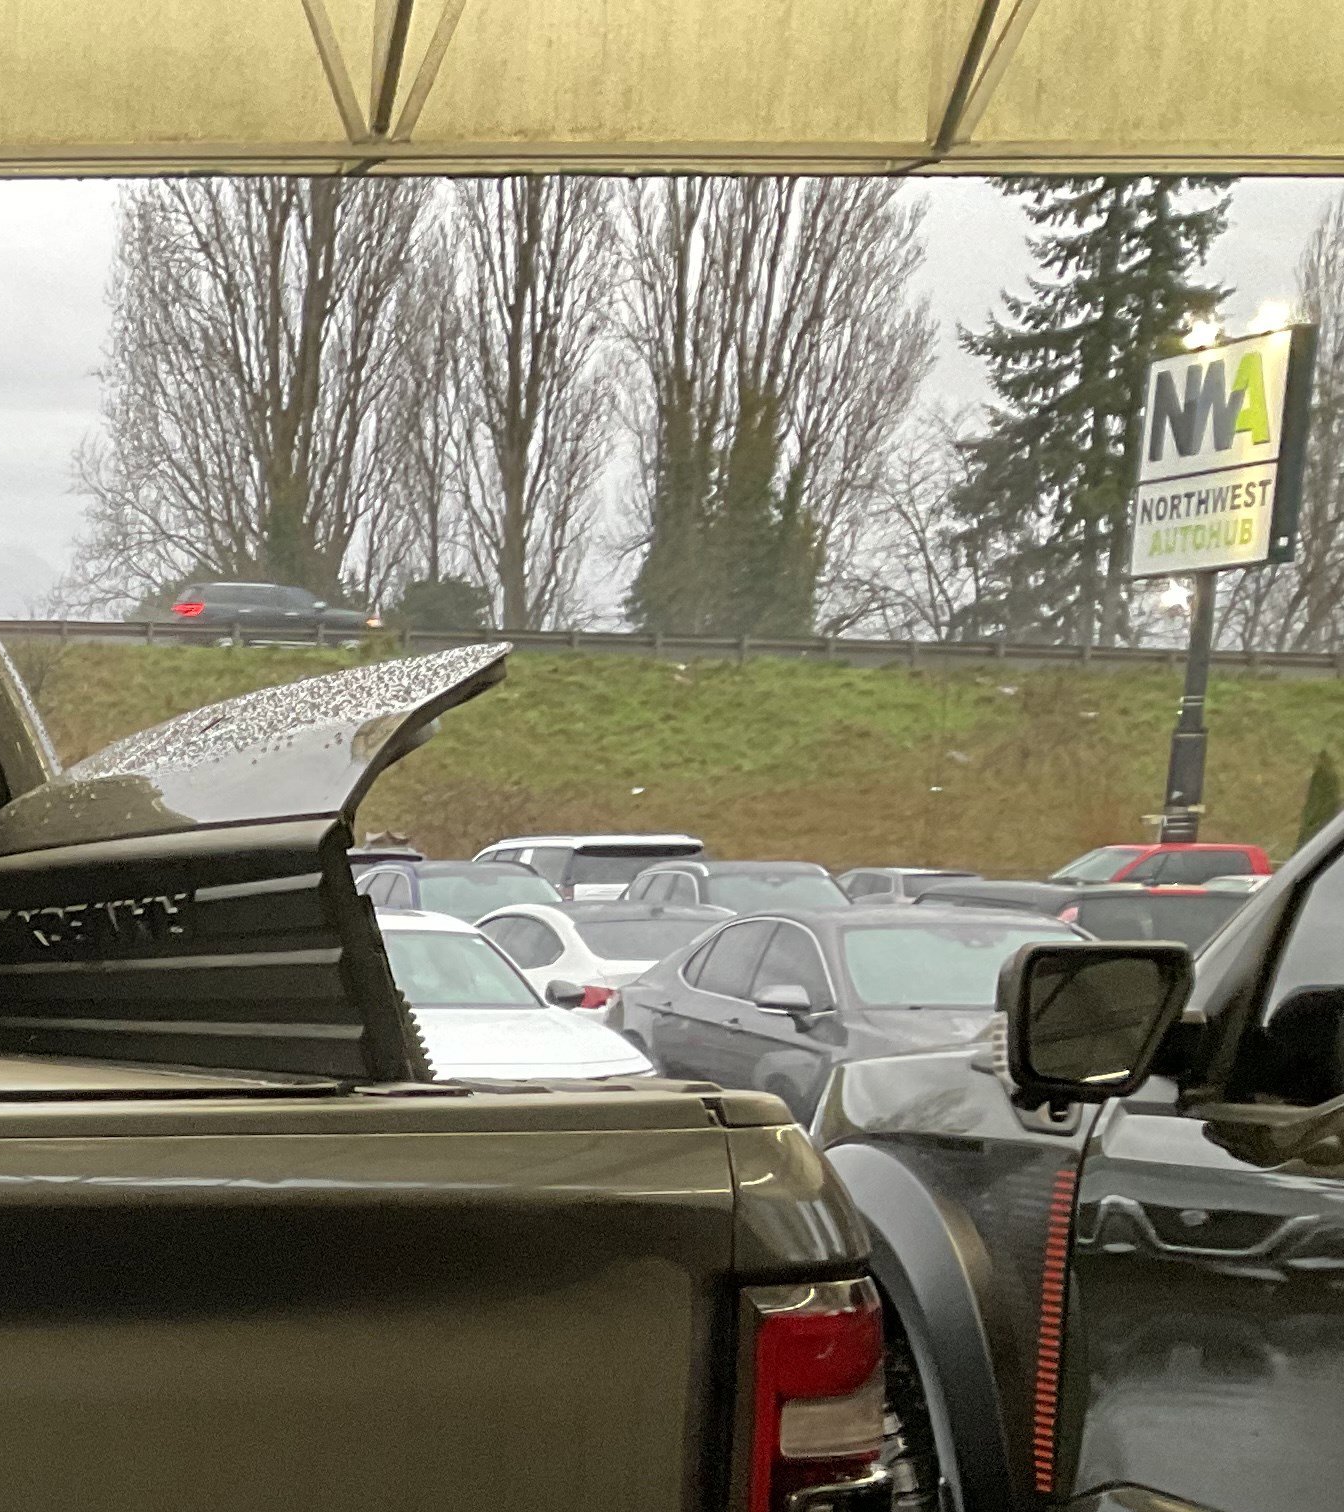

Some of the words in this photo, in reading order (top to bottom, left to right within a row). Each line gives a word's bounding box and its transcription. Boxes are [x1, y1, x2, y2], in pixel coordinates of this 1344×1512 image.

[1149, 351, 1271, 462] NWA
[1141, 479, 1271, 522] NORTHWEST
[1150, 518, 1253, 554] AUTOHUB
